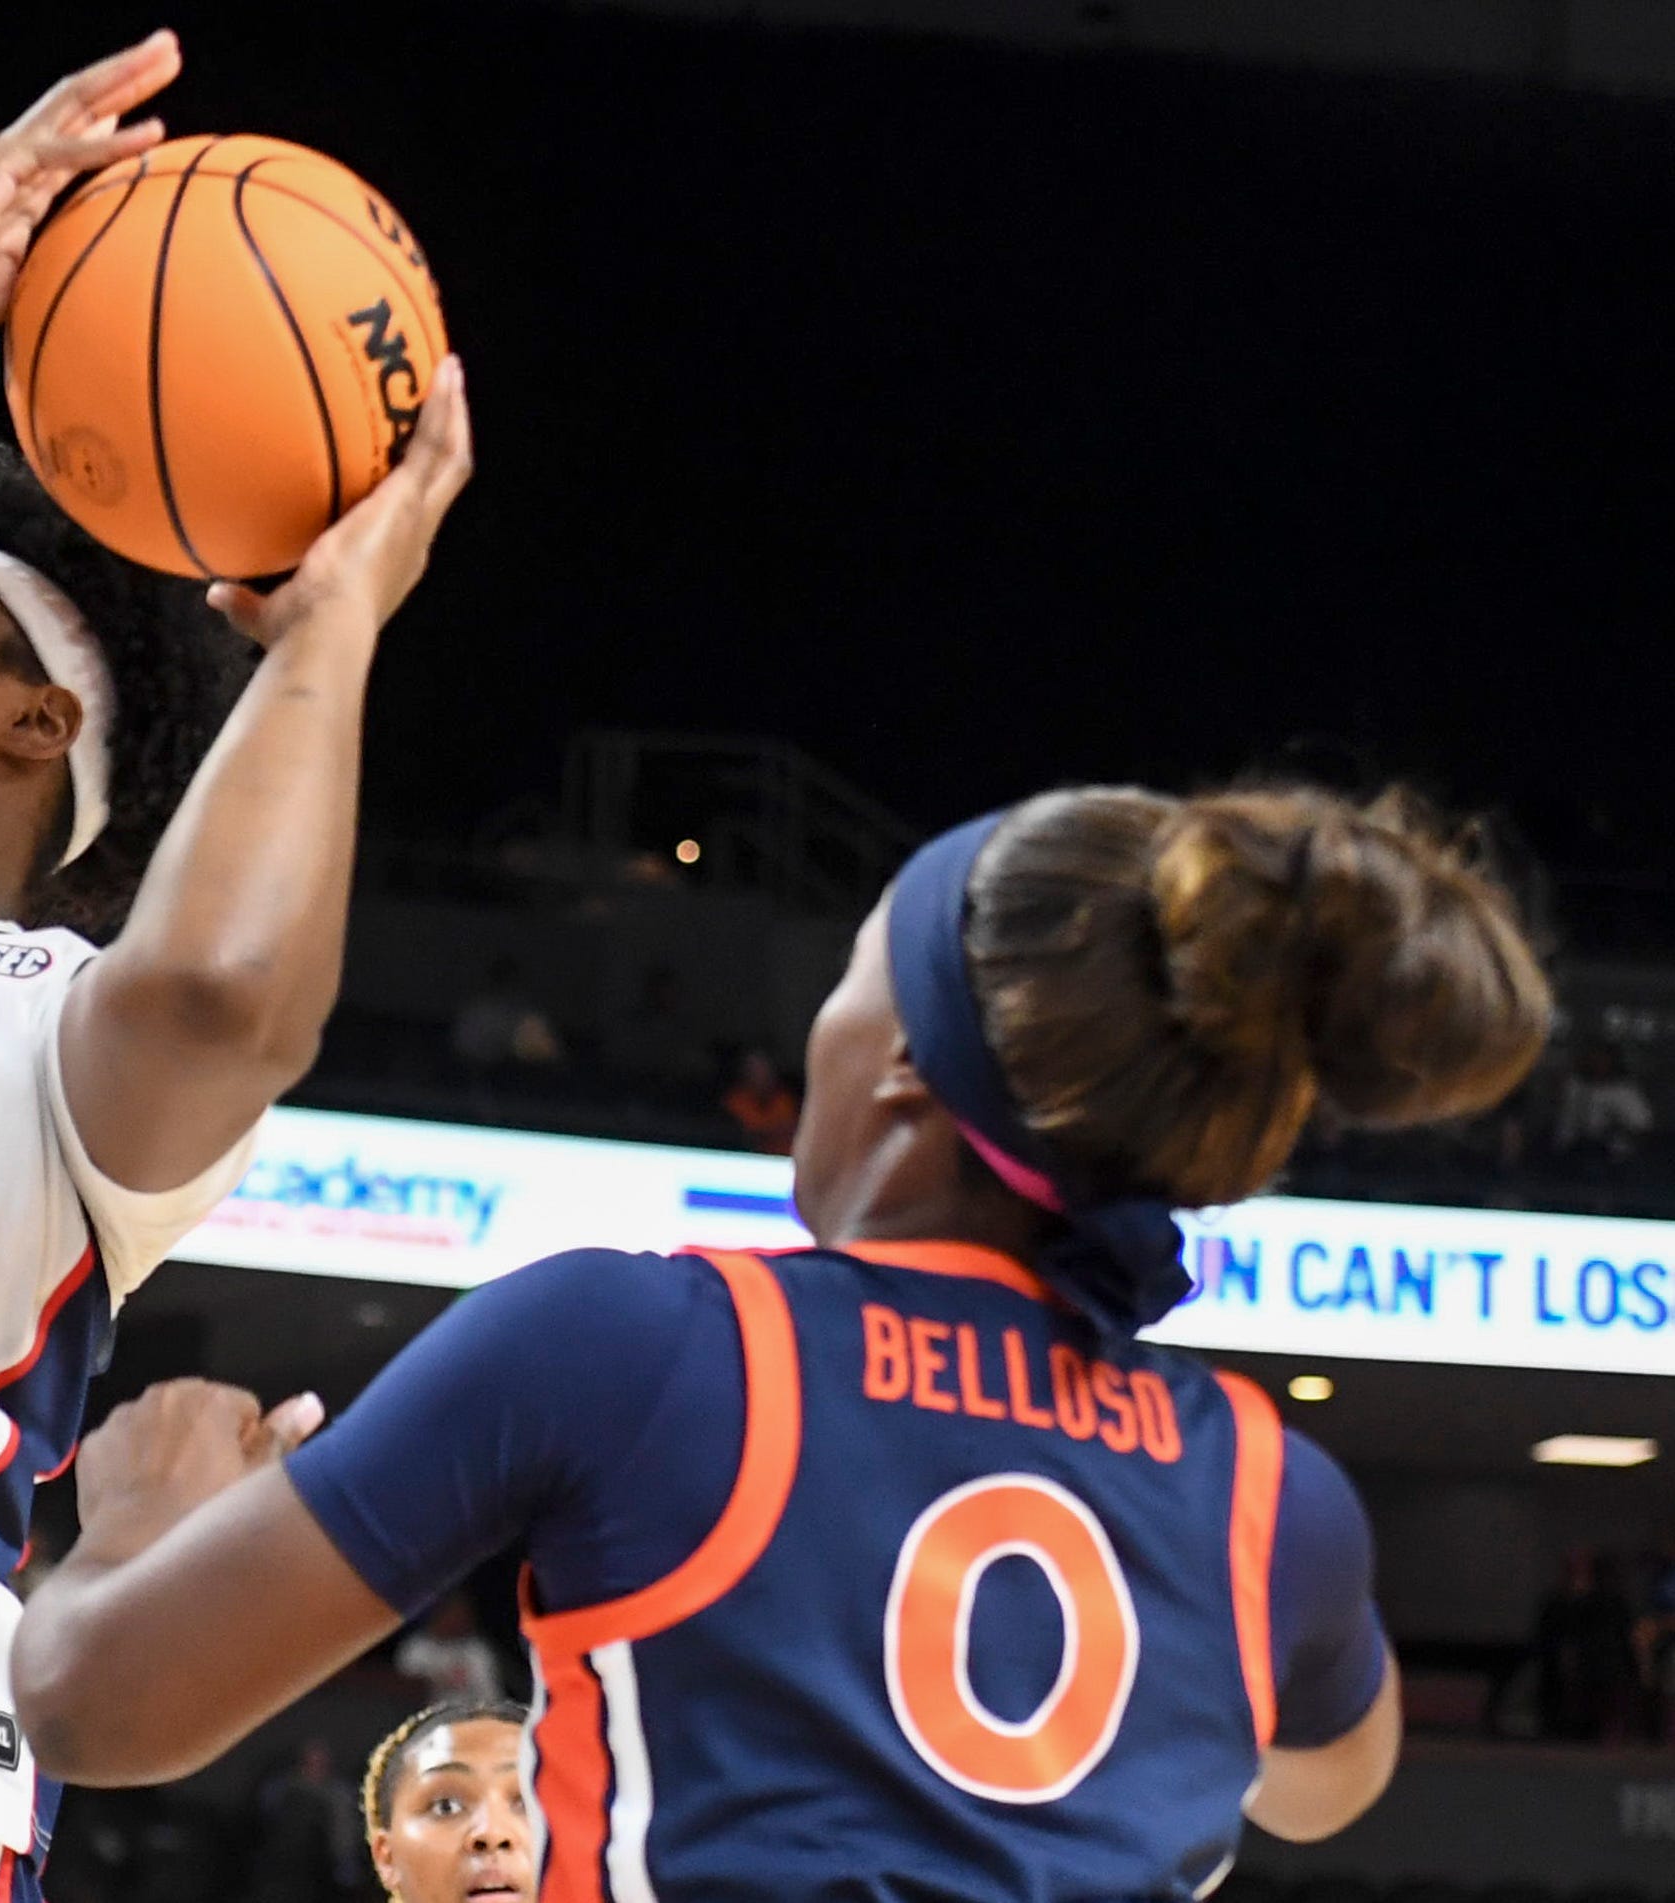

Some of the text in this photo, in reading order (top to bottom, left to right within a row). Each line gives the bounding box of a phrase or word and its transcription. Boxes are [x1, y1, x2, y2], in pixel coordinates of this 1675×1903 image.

[229, 1153, 505, 1245] cademy
[1290, 1240, 1503, 1320] CAN'T
[1535, 1255, 1675, 1331] LOS
[861, 1302, 1184, 1465] BELLOSO
[883, 1471, 1140, 1806] 0
